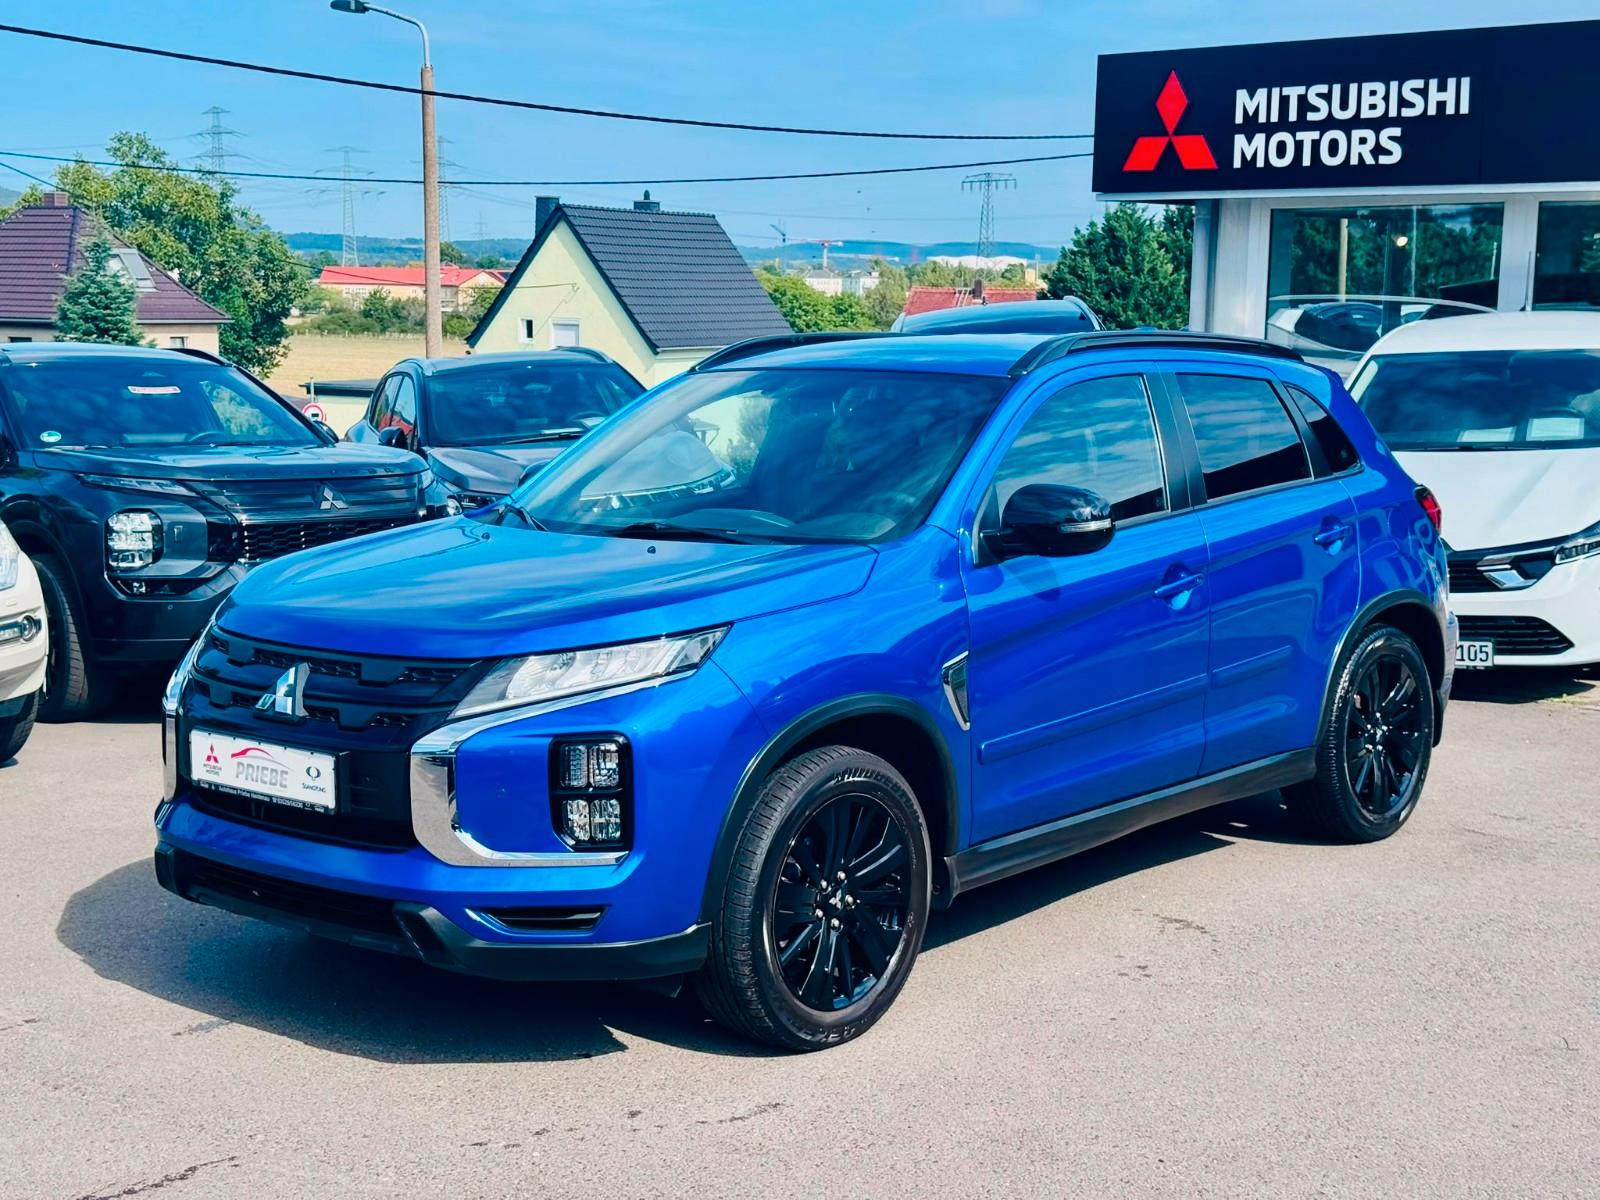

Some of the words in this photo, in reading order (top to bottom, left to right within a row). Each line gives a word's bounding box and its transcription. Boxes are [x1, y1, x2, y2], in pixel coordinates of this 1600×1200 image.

[1234, 76, 1470, 124] MITSUBISHI
[1233, 127, 1402, 169] MOTORS
[1456, 644, 1489, 662] 105
[236, 761, 288, 788] PRIEBE
